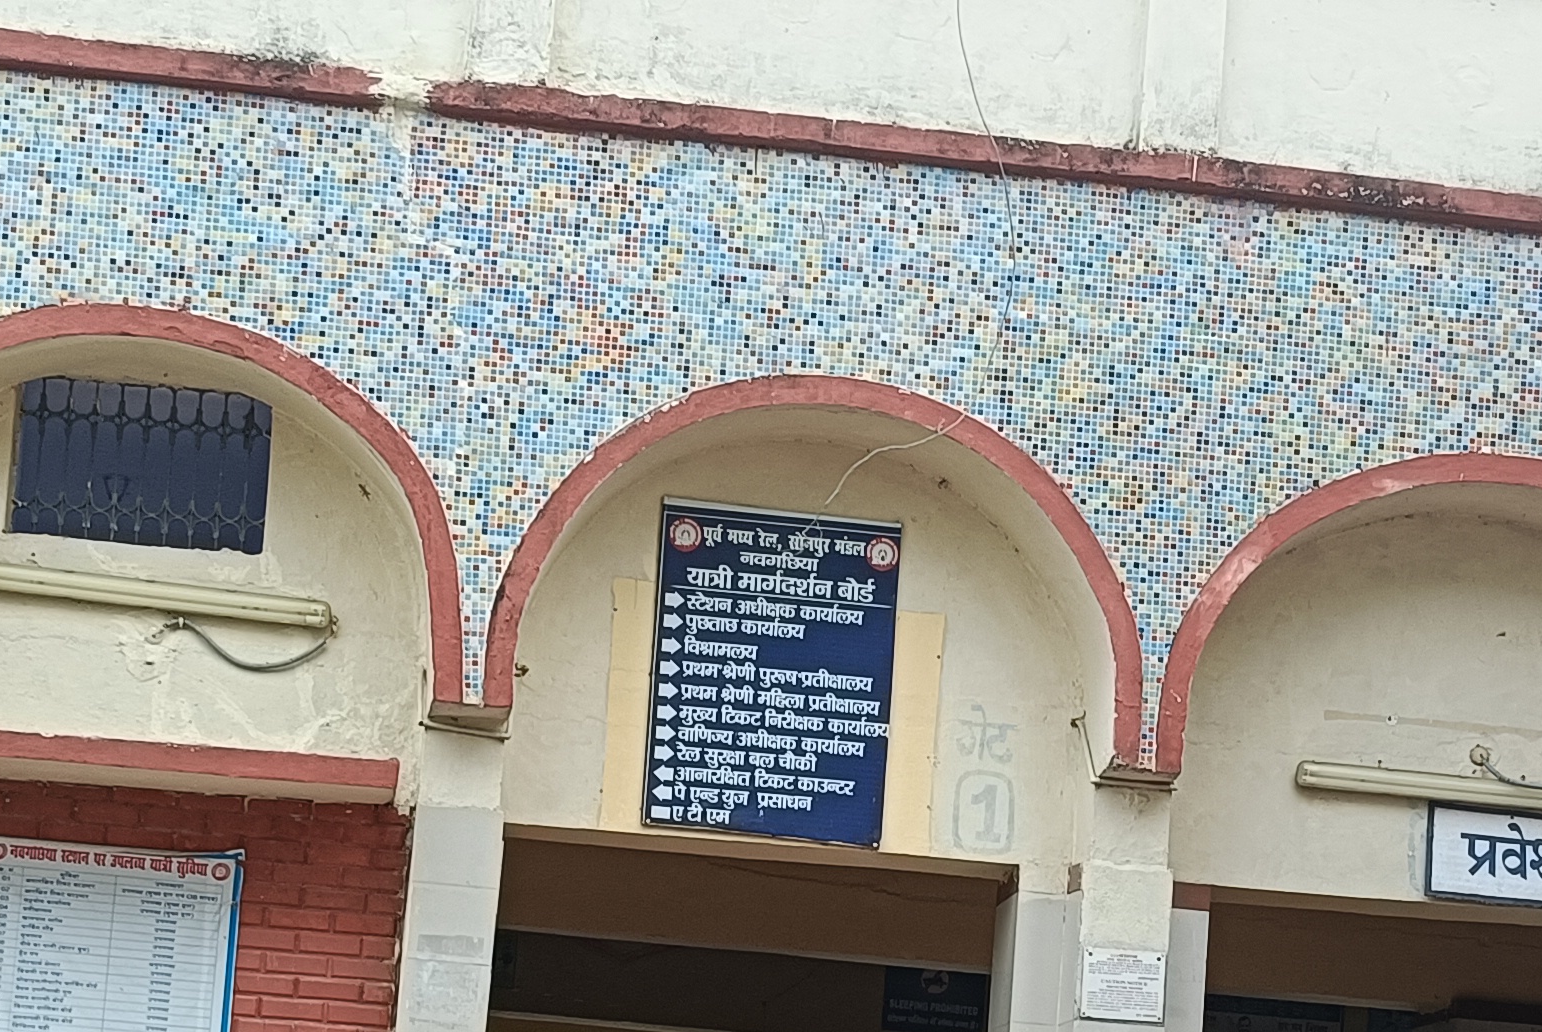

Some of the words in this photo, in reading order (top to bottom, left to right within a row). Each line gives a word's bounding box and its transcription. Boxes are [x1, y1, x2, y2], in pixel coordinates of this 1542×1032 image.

[703, 524, 723, 547] पूर्व
[727, 528, 754, 547] मध्य
[787, 531, 831, 557] सोनपुर
[834, 535, 866, 557] मंडल
[740, 552, 819, 572] नवगछिया
[686, 565, 733, 590] यात्री
[737, 569, 833, 599] मार्गदर्शन
[837, 578, 876, 603] बोर्ड
[686, 592, 733, 614] स्टेशन
[735, 596, 797, 620] अधीक्षक
[800, 603, 864, 626] कार्यालय
[685, 613, 739, 635] पुछताछ
[741, 617, 805, 640] कार्यालय
[722, 662, 756, 682] श्रेणी
[801, 669, 873, 693] प्रतीक्षालय
[680, 683, 718, 702] प्रथम
[720, 684, 755, 705] श्रेणी
[757, 688, 806, 710] महिला
[808, 692, 880, 716] प्रतीक्षालय
[678, 705, 718, 725] मुख्य
[721, 706, 762, 726] टिकट
[765, 709, 825, 731] निरीक्षक
[828, 716, 890, 739] कार्यालय
[677, 724, 734, 745] वाणिज्य
[736, 729, 798, 750] अधीक्षक
[801, 734, 865, 758] कार्यालय
[676, 742, 702, 763] रेल
[704, 745, 746, 768] सुरक्षा
[748, 751, 776, 769] बल
[778, 750, 818, 772] चौकी
[674, 782, 688, 801] पे
[689, 785, 720, 804] एन्ड
[757, 791, 813, 812] प्रसाधन
[754, 770, 795, 791] टिकट
[797, 777, 856, 797] काउन्टर
[672, 805, 685, 822] ए
[686, 803, 702, 823] टी
[706, 808, 732, 825] एम
[970, 783, 1002, 845] 1
[93, 851, 108, 867] पर
[929, 1001, 979, 1016] PROHIBITED
